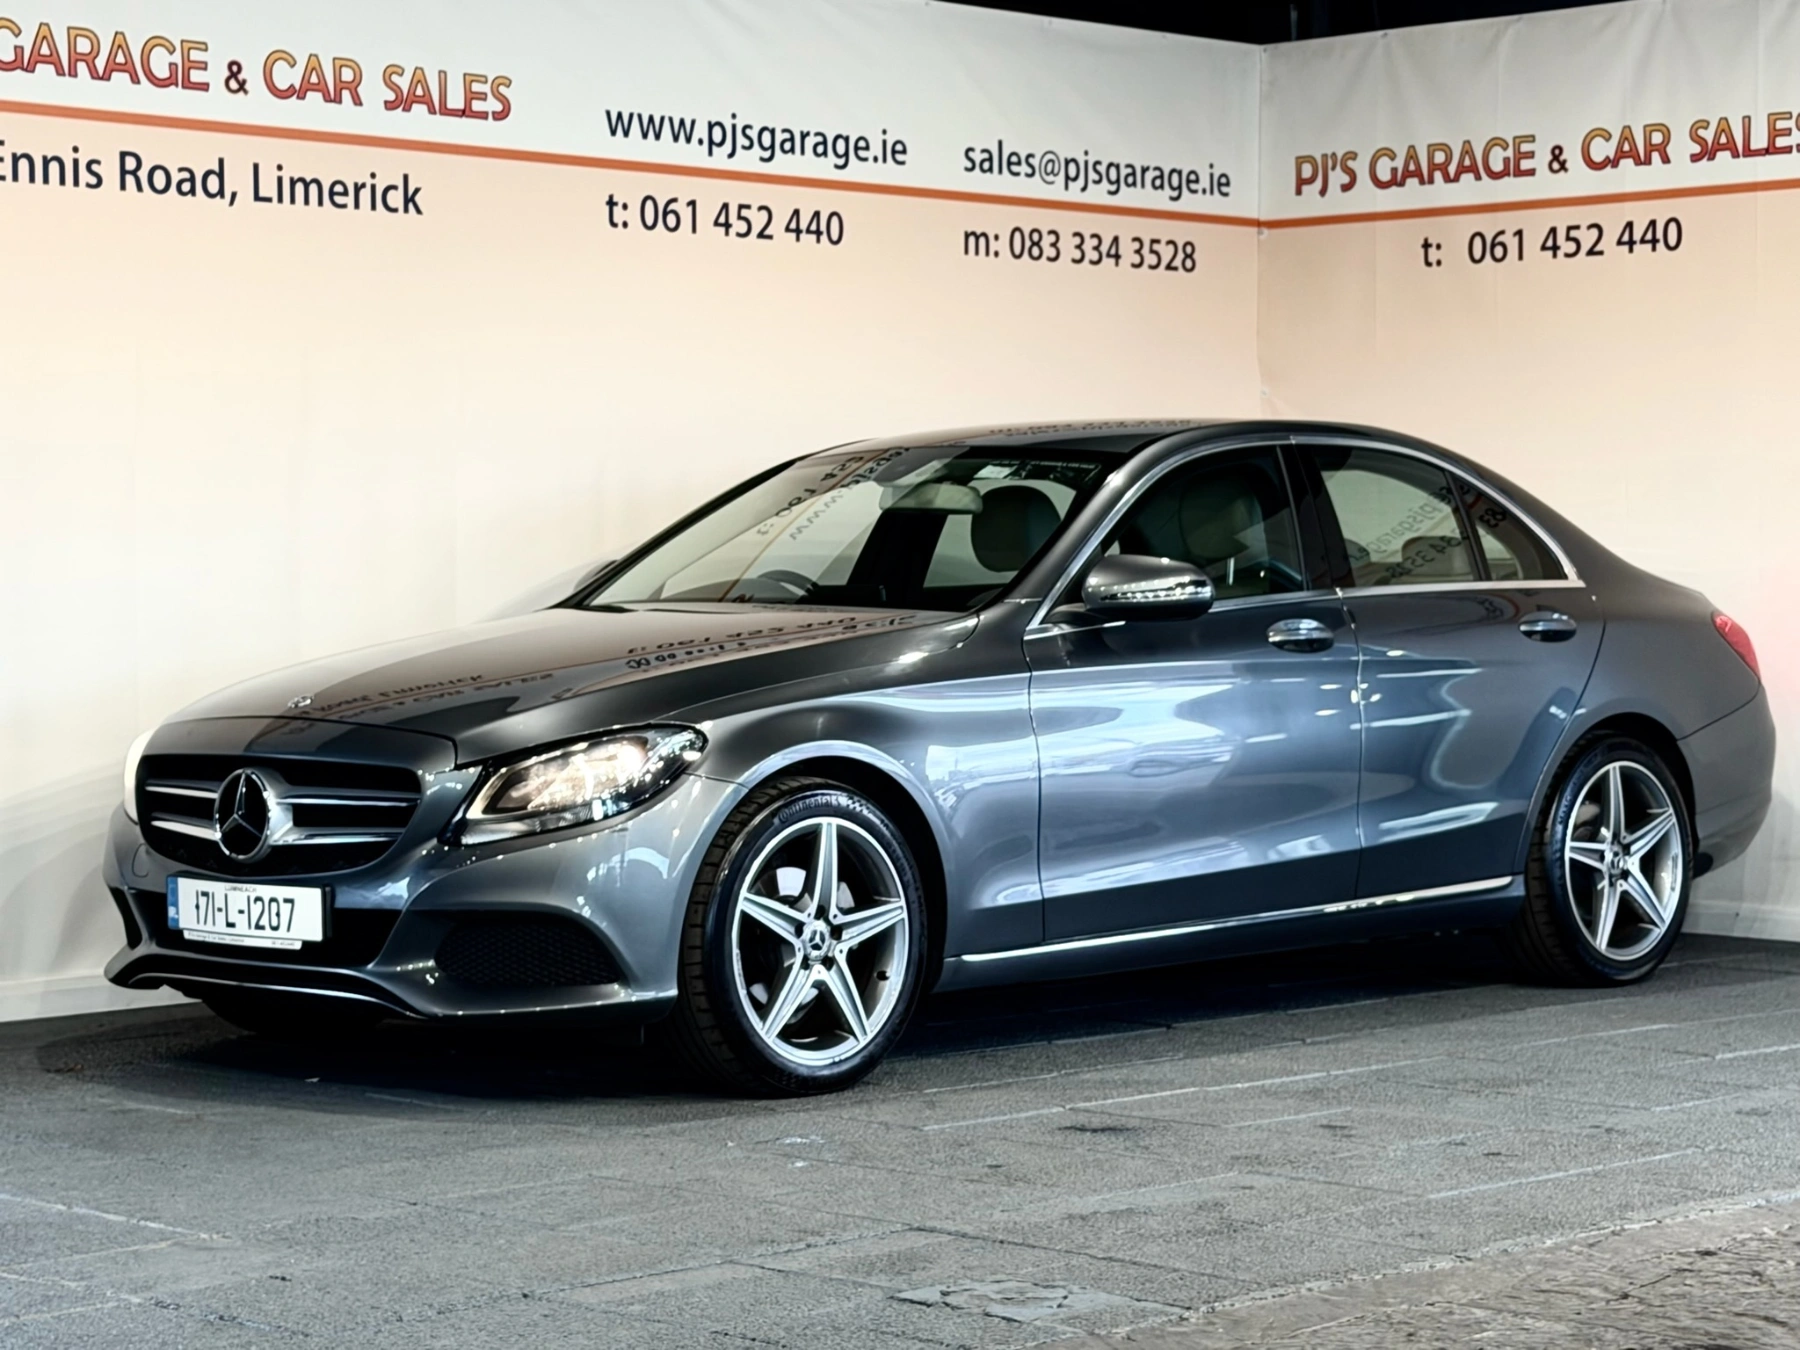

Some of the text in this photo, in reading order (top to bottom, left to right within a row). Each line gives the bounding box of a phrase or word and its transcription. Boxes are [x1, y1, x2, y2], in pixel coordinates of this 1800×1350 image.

[0, 16, 513, 122] GARAGE & CAR SALES
[605, 108, 909, 171] www.pjsgarage.ie
[963, 139, 1232, 203] sales@pjsgarage.ie
[1294, 110, 1800, 198] PJ'S GARAGE & CAR SALE
[118, 149, 239, 209] Road,
[252, 161, 424, 216] Limerick
[605, 192, 845, 247] t: 061 452 440
[964, 224, 1198, 274] m: 083 334 3528
[1420, 215, 1684, 269] t: 061 452 440
[194, 888, 296, 933] 171-L-1207
